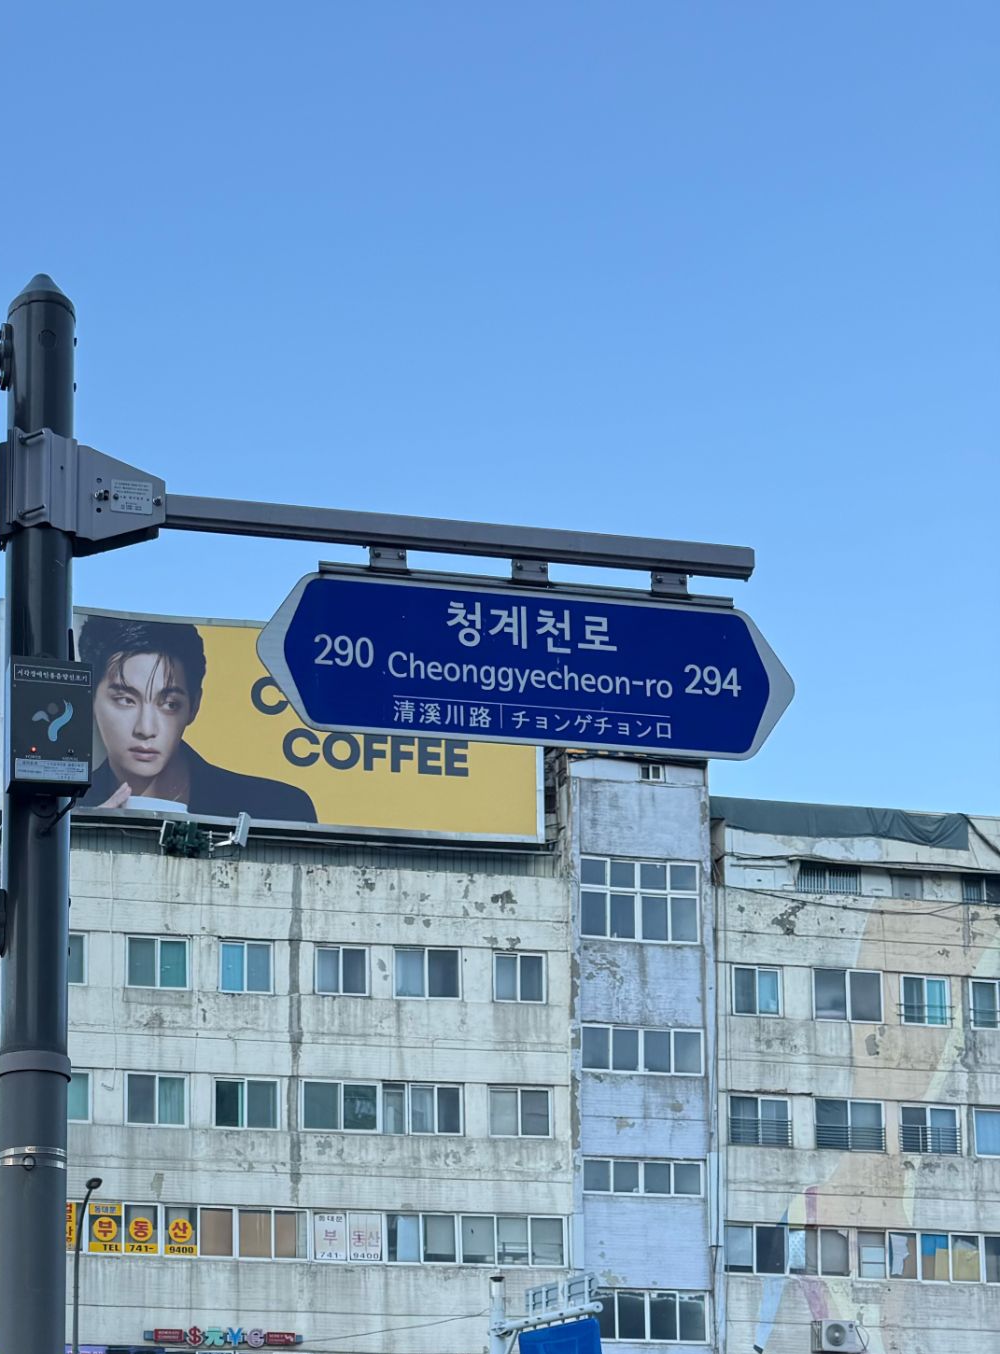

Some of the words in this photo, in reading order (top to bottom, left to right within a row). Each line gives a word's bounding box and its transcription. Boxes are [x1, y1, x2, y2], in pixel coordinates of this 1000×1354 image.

[446, 600, 618, 655] 청계천로
[313, 633, 375, 669] 290
[387, 650, 674, 700] Cheonggyecheon-ro
[683, 663, 742, 698] 294
[393, 699, 493, 729] 清溪川路
[511, 709, 673, 740] チョンゲチョンロ
[282, 727, 469, 778] COFFEE
[98, 1220, 113, 1238] 부
[133, 1220, 149, 1238] 동
[171, 1222, 188, 1239] 산
[323, 1229, 338, 1247] 부
[103, 1243, 120, 1252] TEL
[169, 1246, 194, 1254] 9400
